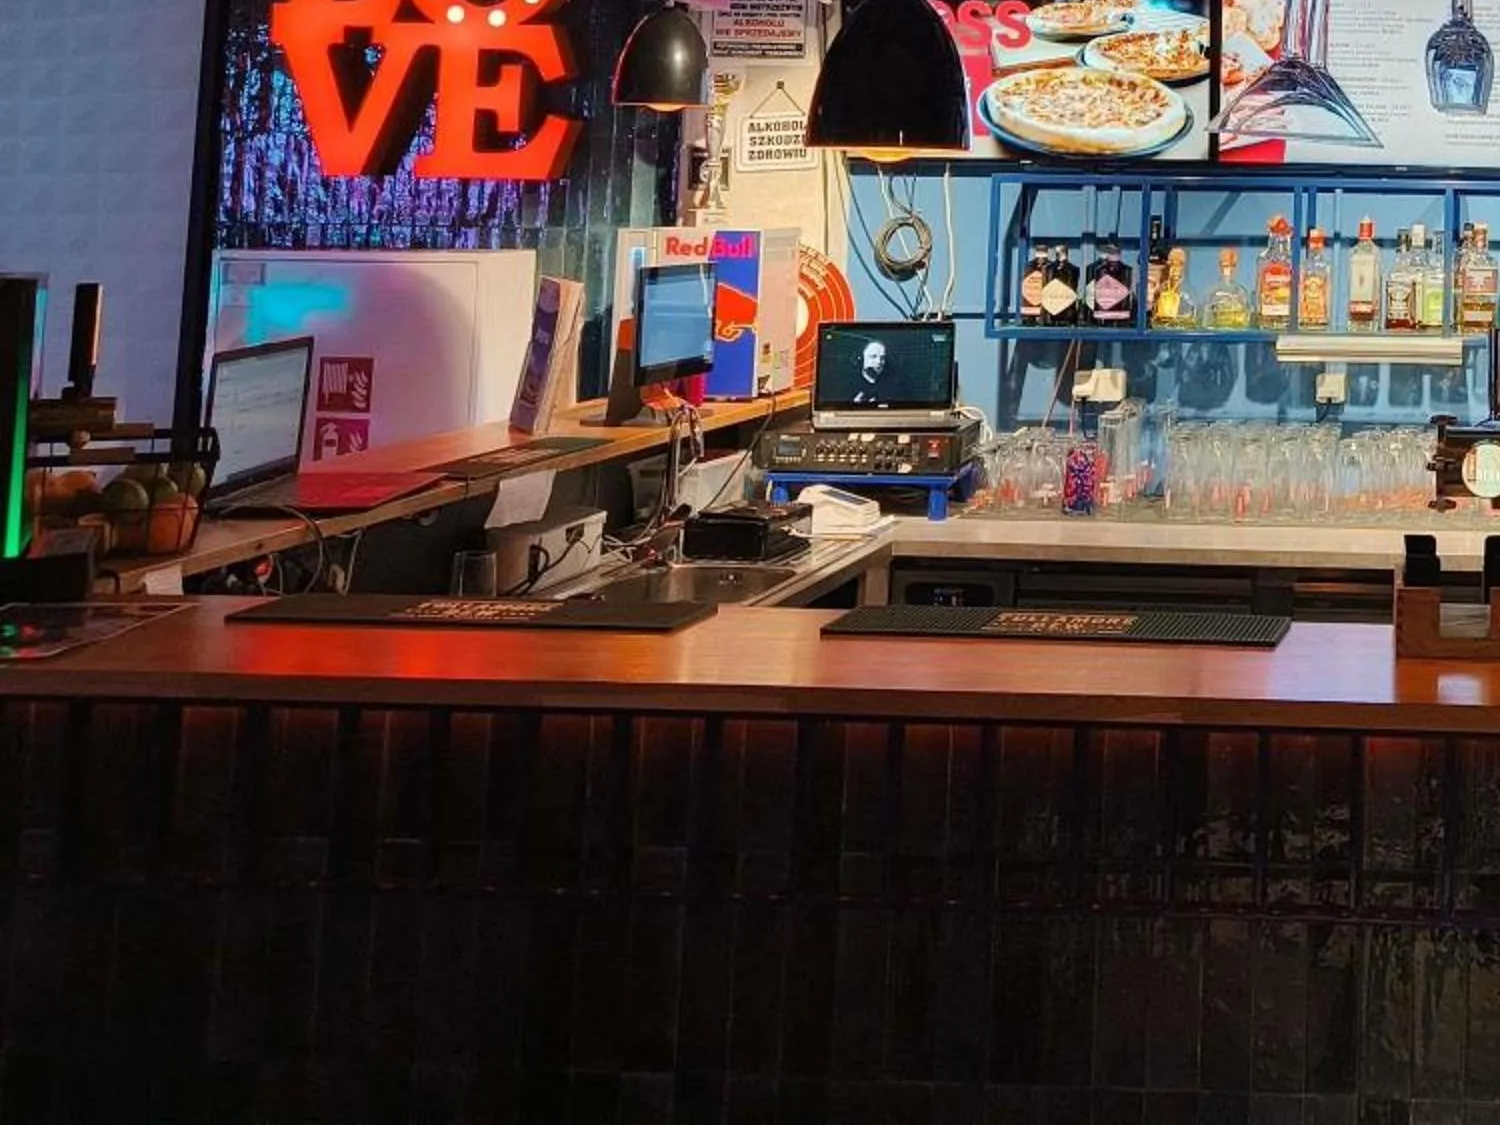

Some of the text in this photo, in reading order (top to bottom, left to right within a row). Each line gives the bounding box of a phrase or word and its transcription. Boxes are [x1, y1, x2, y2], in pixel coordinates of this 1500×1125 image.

[748, 149, 807, 161] ZDROWIU
[665, 235, 753, 257] Red Bull
